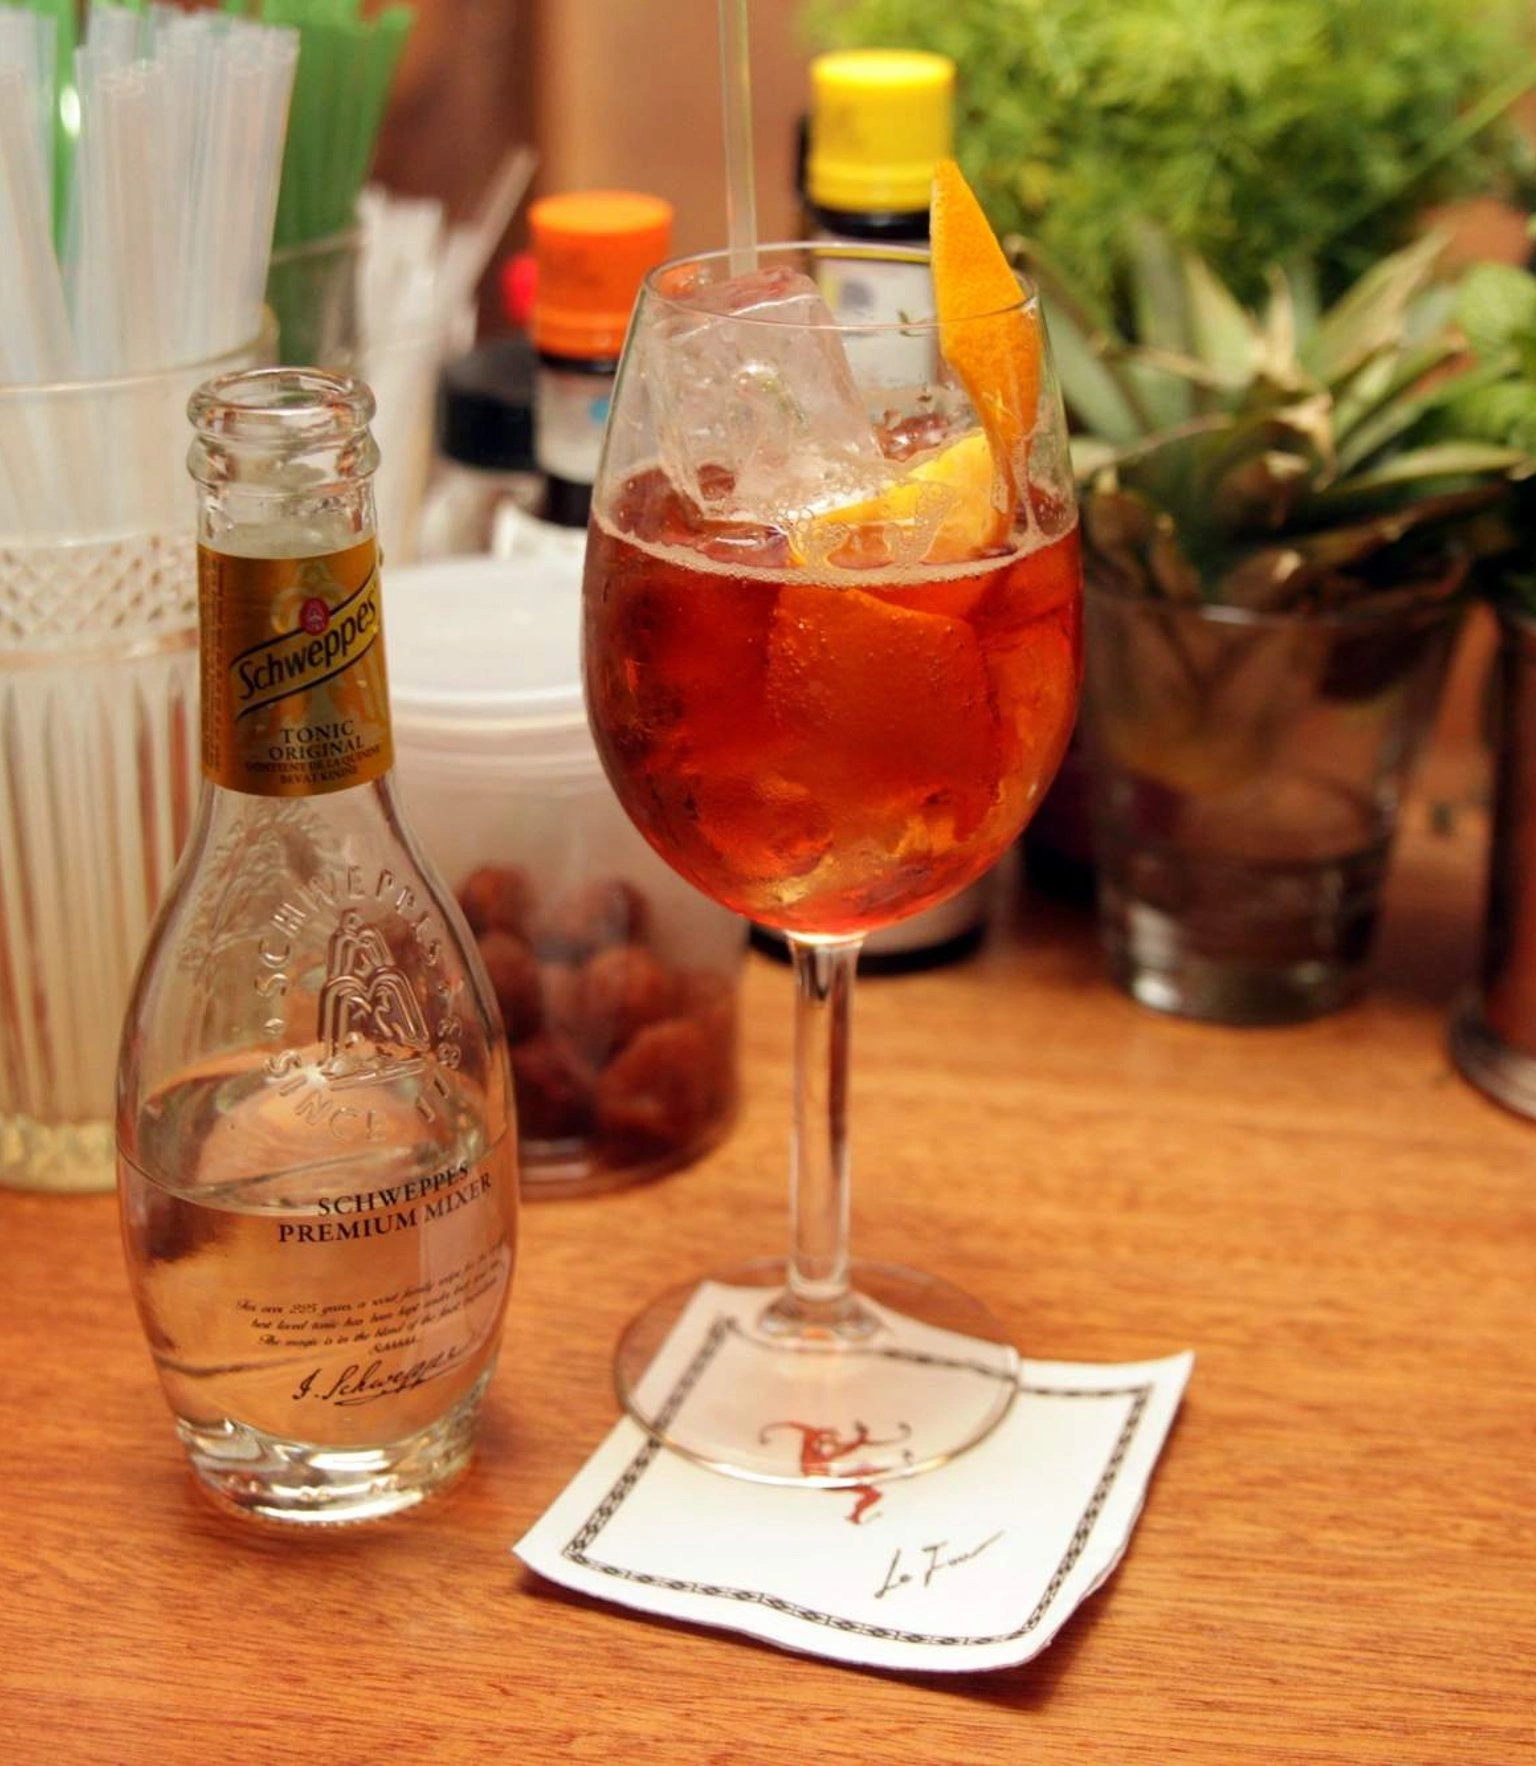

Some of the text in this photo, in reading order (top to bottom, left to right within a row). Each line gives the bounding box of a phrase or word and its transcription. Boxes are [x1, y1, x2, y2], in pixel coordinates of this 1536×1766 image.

[239, 588, 378, 700] Schweppes
[267, 735, 365, 761] ORIGINAL
[281, 720, 355, 744] TONIC
[277, 1171, 492, 1243] PREMIUM MIXER
[317, 1164, 469, 1217] SCHWEPPES
